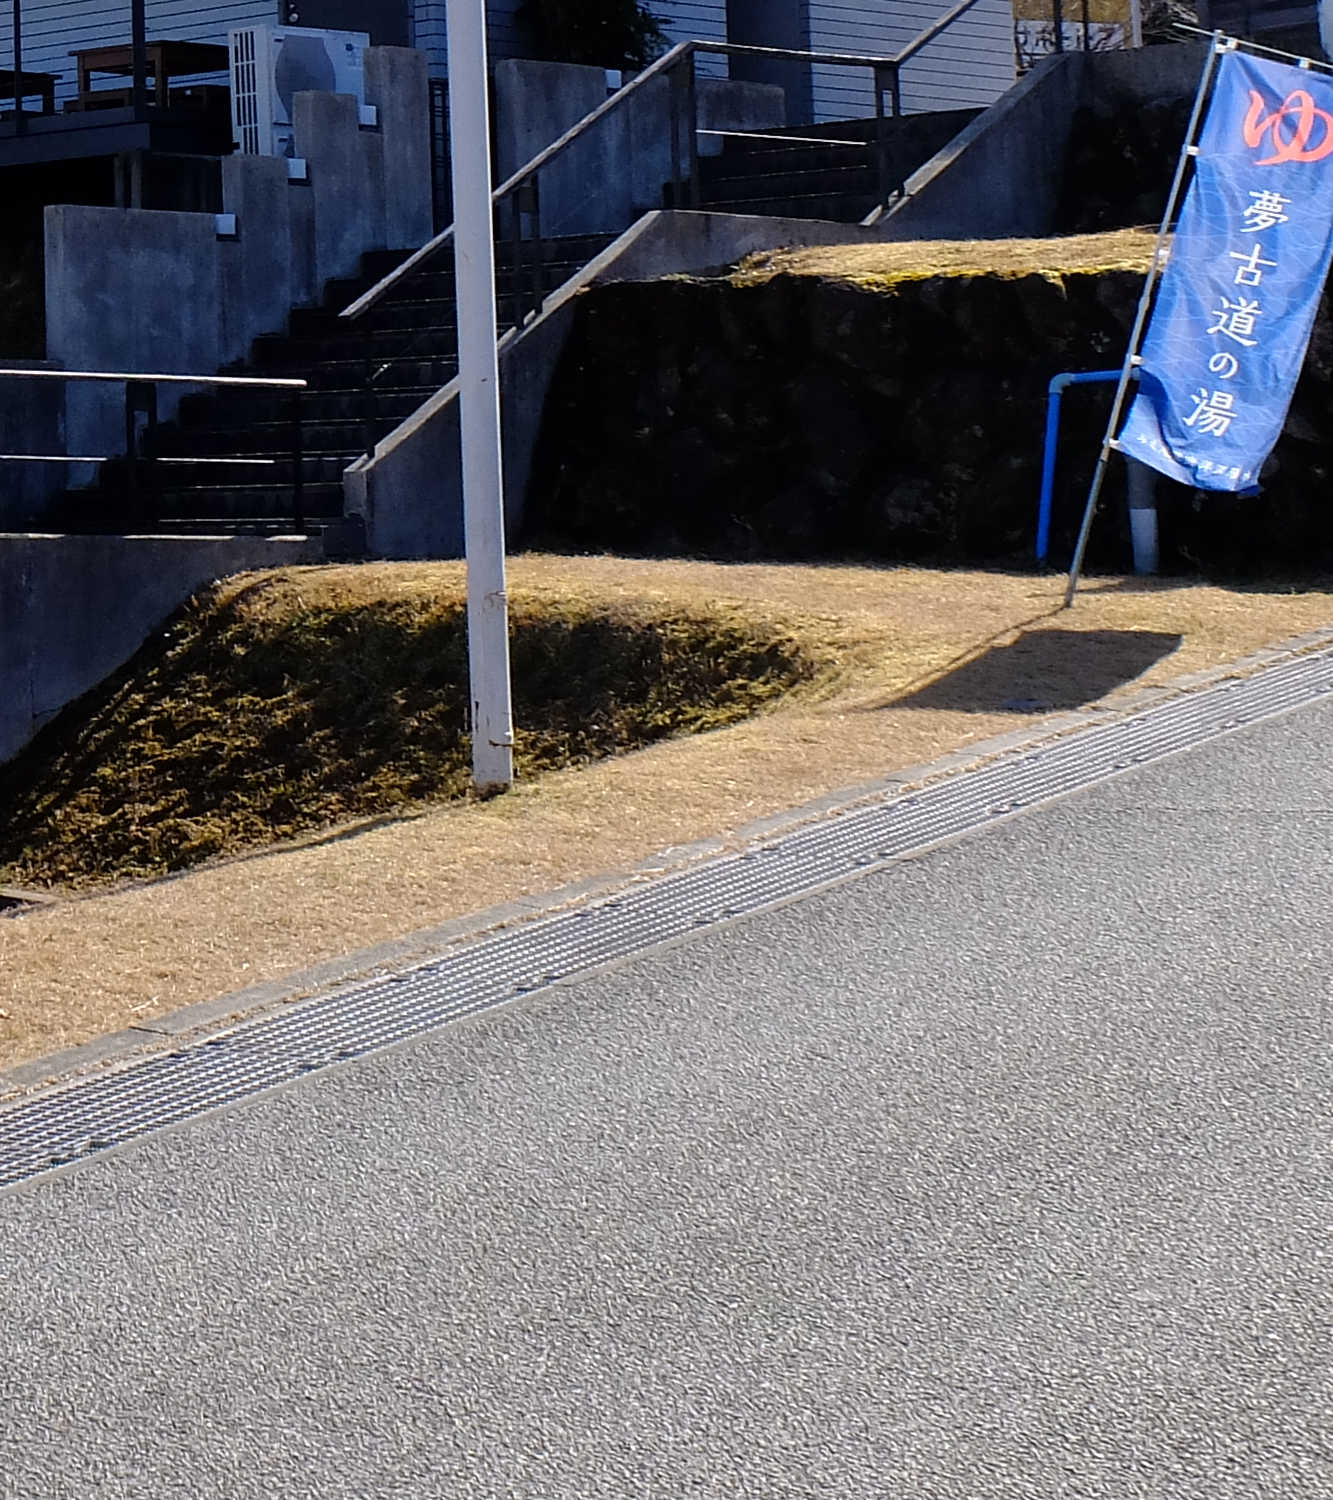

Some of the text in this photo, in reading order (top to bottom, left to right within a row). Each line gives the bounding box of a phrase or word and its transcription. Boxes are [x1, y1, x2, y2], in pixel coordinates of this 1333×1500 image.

[1243, 90, 1333, 165] ゆ
[1183, 190, 1292, 437] 夢古道の湯
